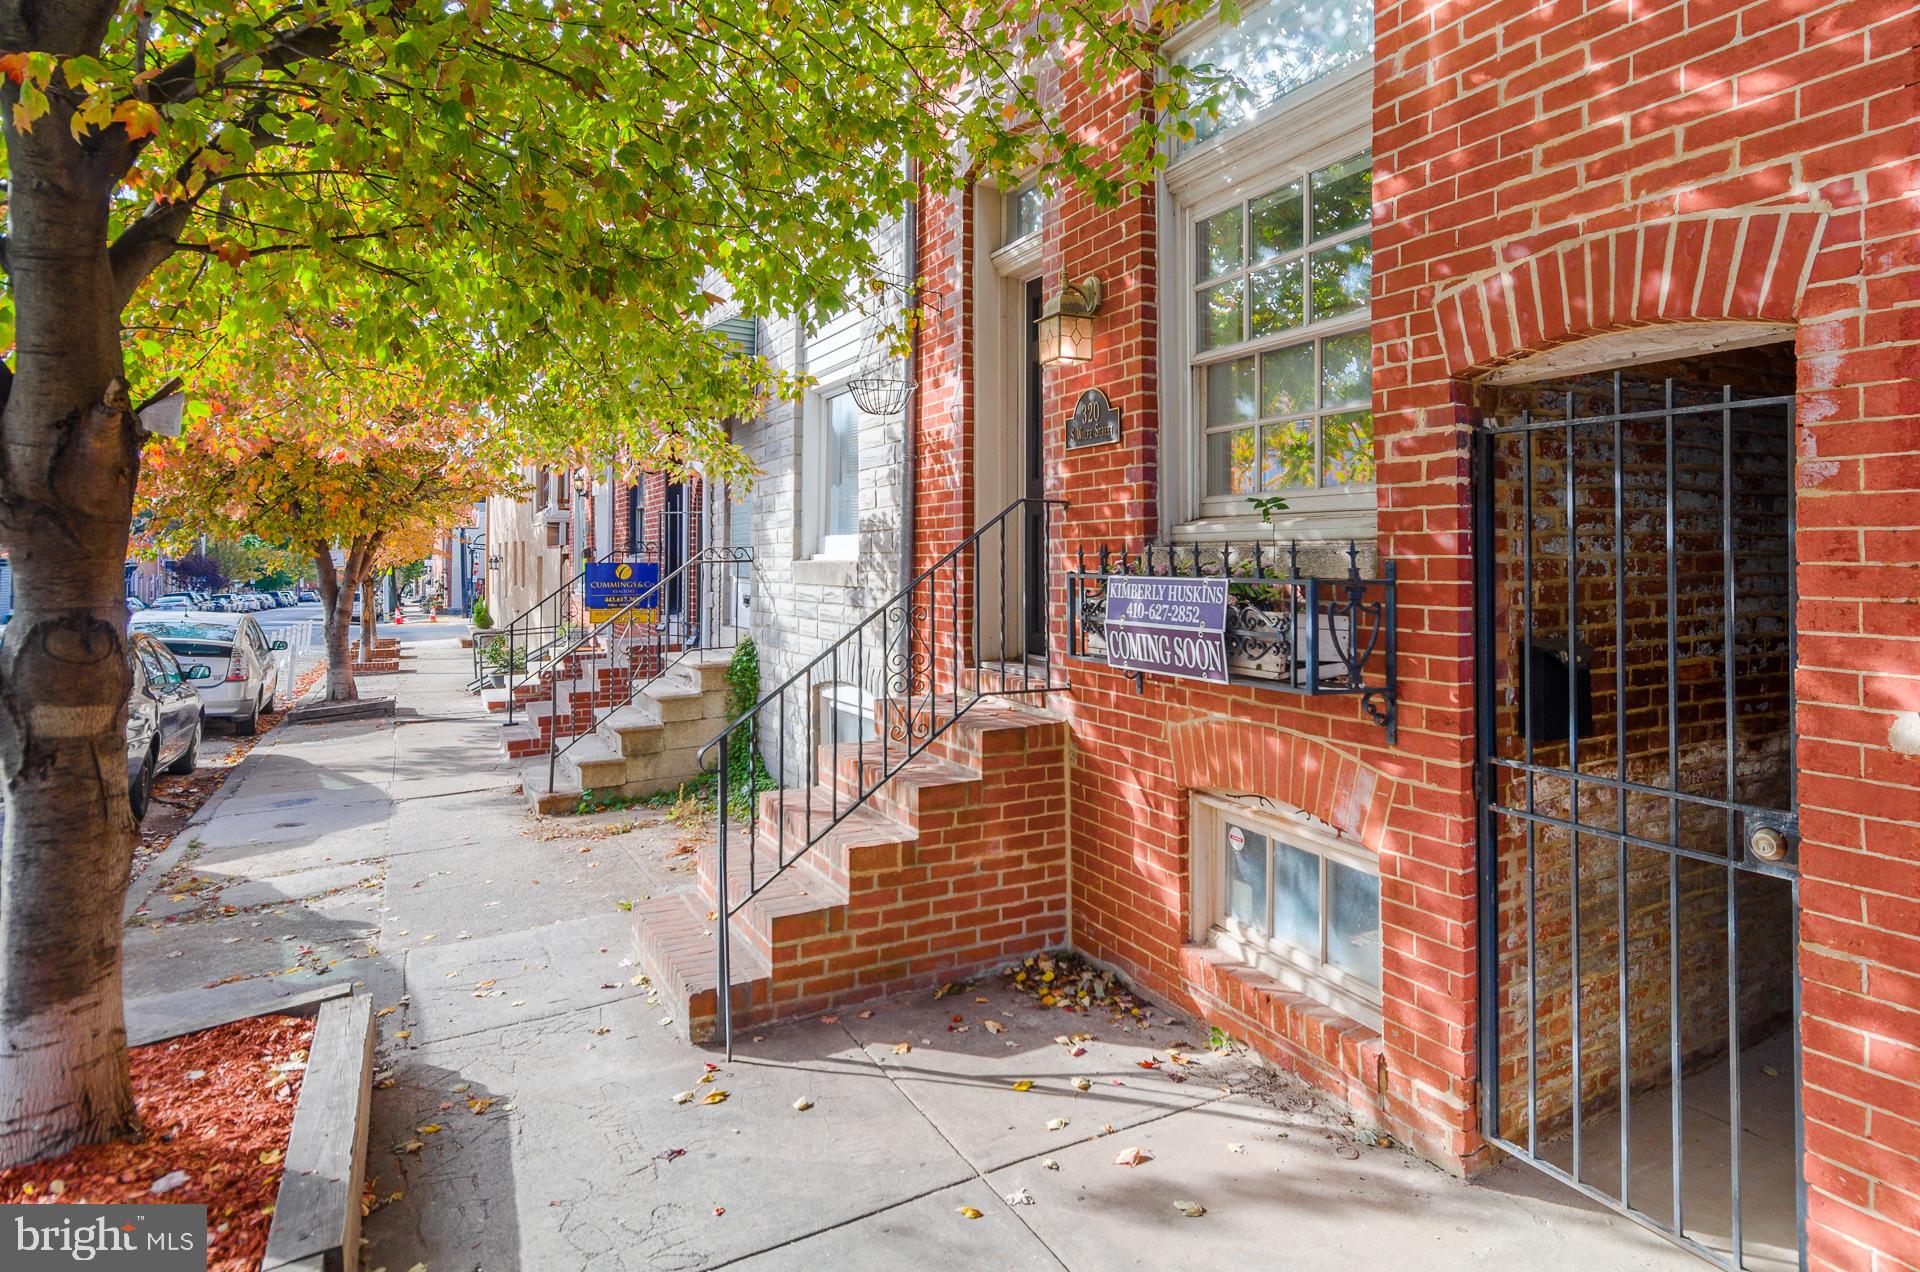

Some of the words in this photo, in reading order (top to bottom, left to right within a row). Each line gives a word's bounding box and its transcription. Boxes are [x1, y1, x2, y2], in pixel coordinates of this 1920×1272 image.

[1081, 401, 1100, 424] 320
[1070, 428, 1075, 442] S
[1109, 582, 1168, 601] KIMBERLY
[1168, 584, 1224, 605] HUSKINS
[1126, 602, 1200, 624] 410-627-2852
[1109, 630, 1171, 666] COMING
[1173, 636, 1222, 673] SOON
